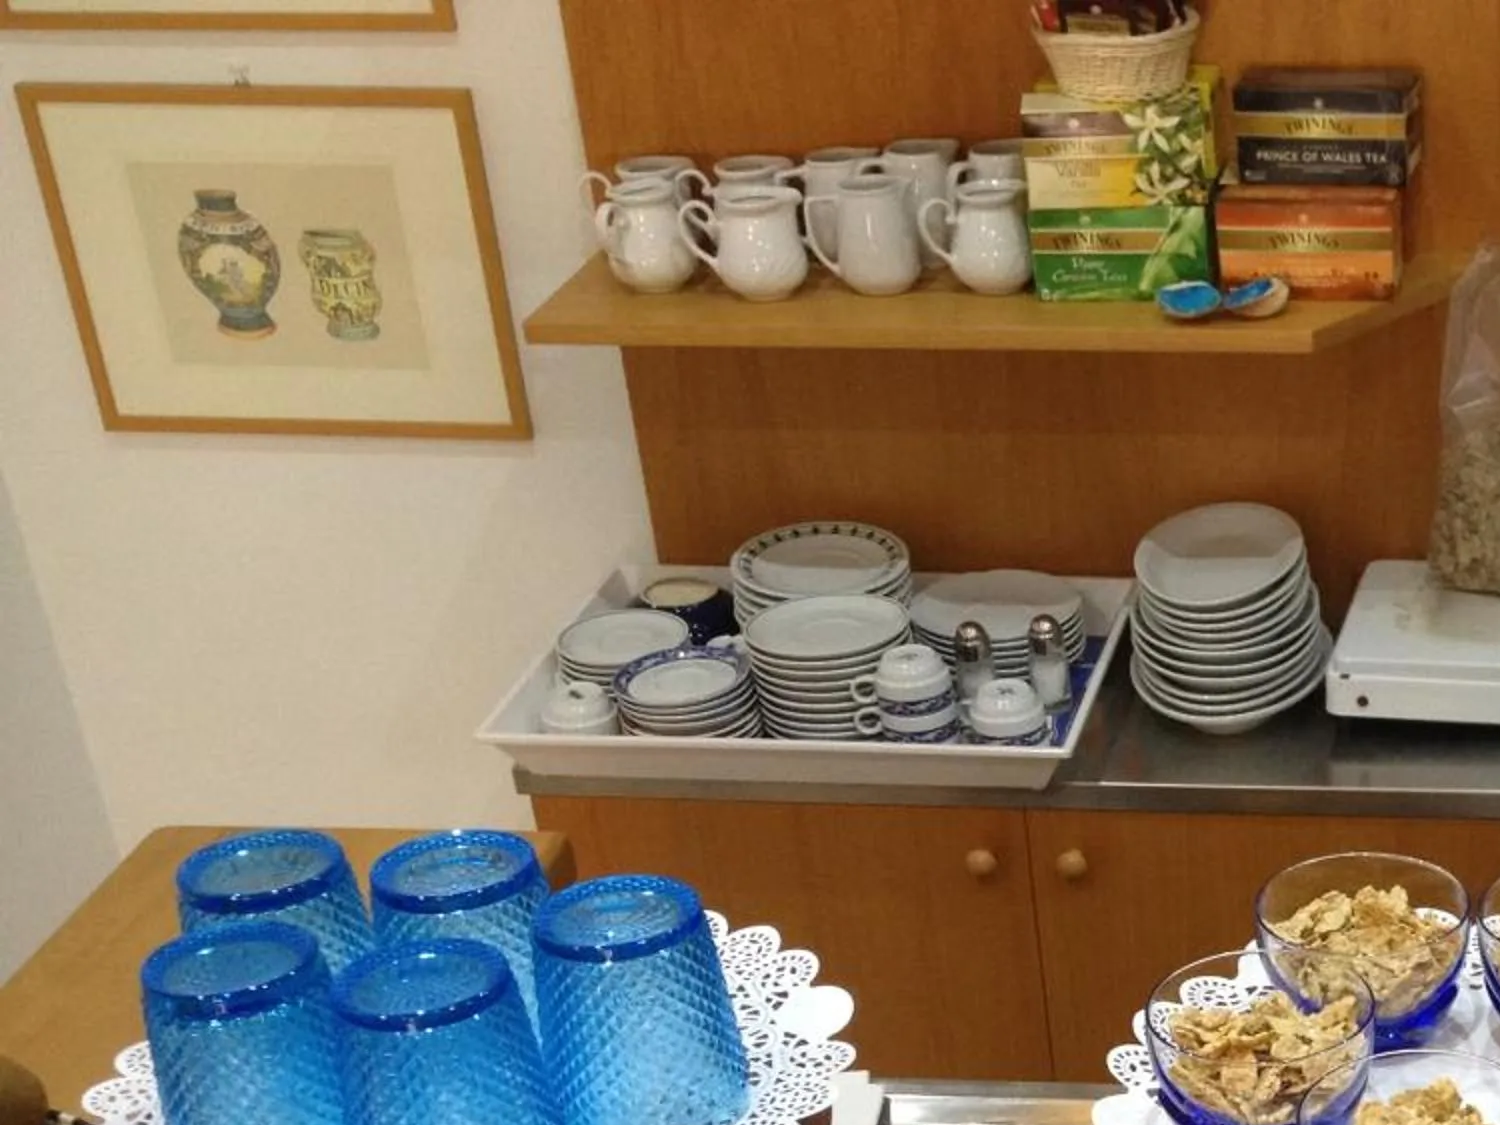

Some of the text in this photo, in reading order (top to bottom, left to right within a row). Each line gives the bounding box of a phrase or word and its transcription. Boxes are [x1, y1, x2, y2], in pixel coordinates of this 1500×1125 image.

[1285, 114, 1355, 136] TWININGS
[1256, 150, 1388, 164] PRINCE OF WALES TEA
[1052, 230, 1122, 250] TWININGS
[1268, 230, 1341, 250] TWININGS
